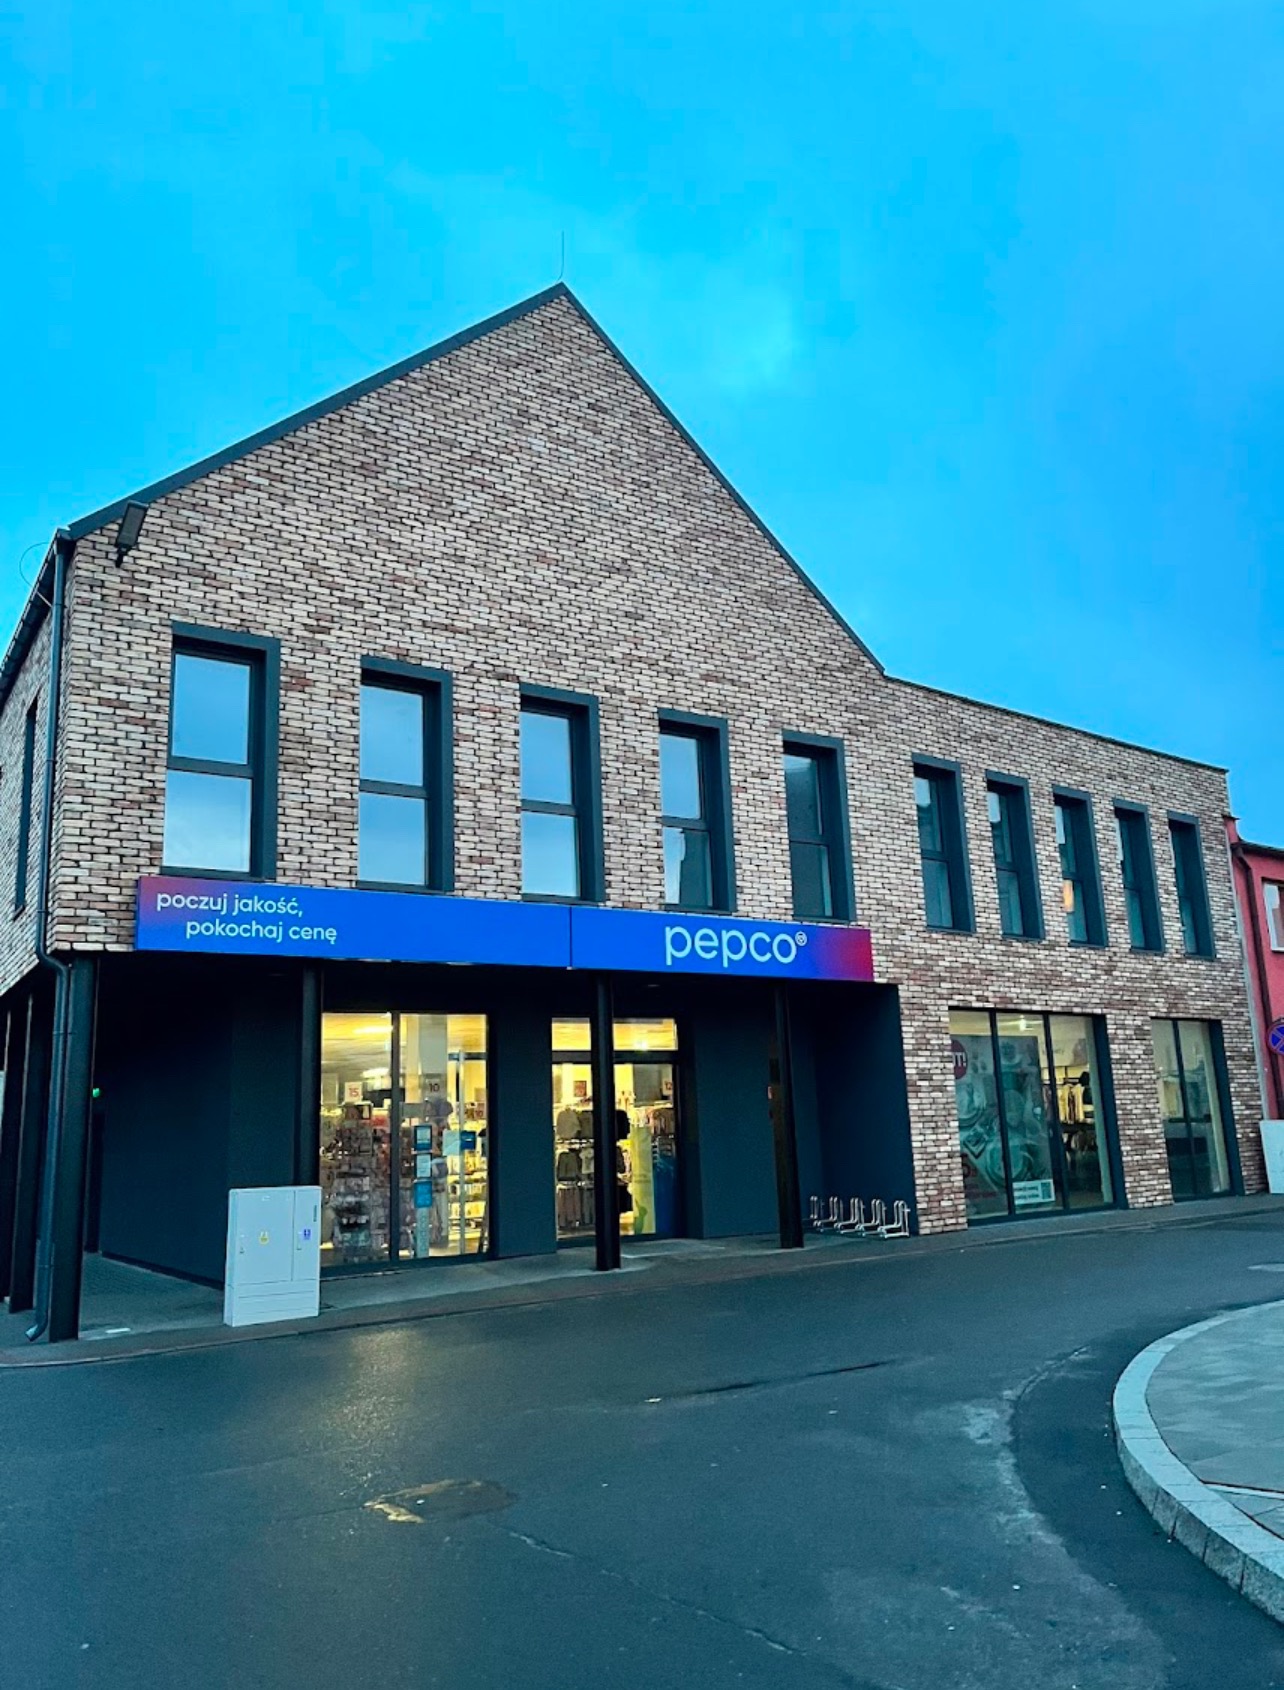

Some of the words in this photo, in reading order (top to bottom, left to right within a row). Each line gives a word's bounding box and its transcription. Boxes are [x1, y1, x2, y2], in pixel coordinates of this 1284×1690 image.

[156, 892, 228, 914] poczuj
[232, 893, 303, 918] jakość,
[185, 918, 283, 942] pokochaj
[289, 925, 338, 944] cenę
[428, 1083, 440, 1093] 10
